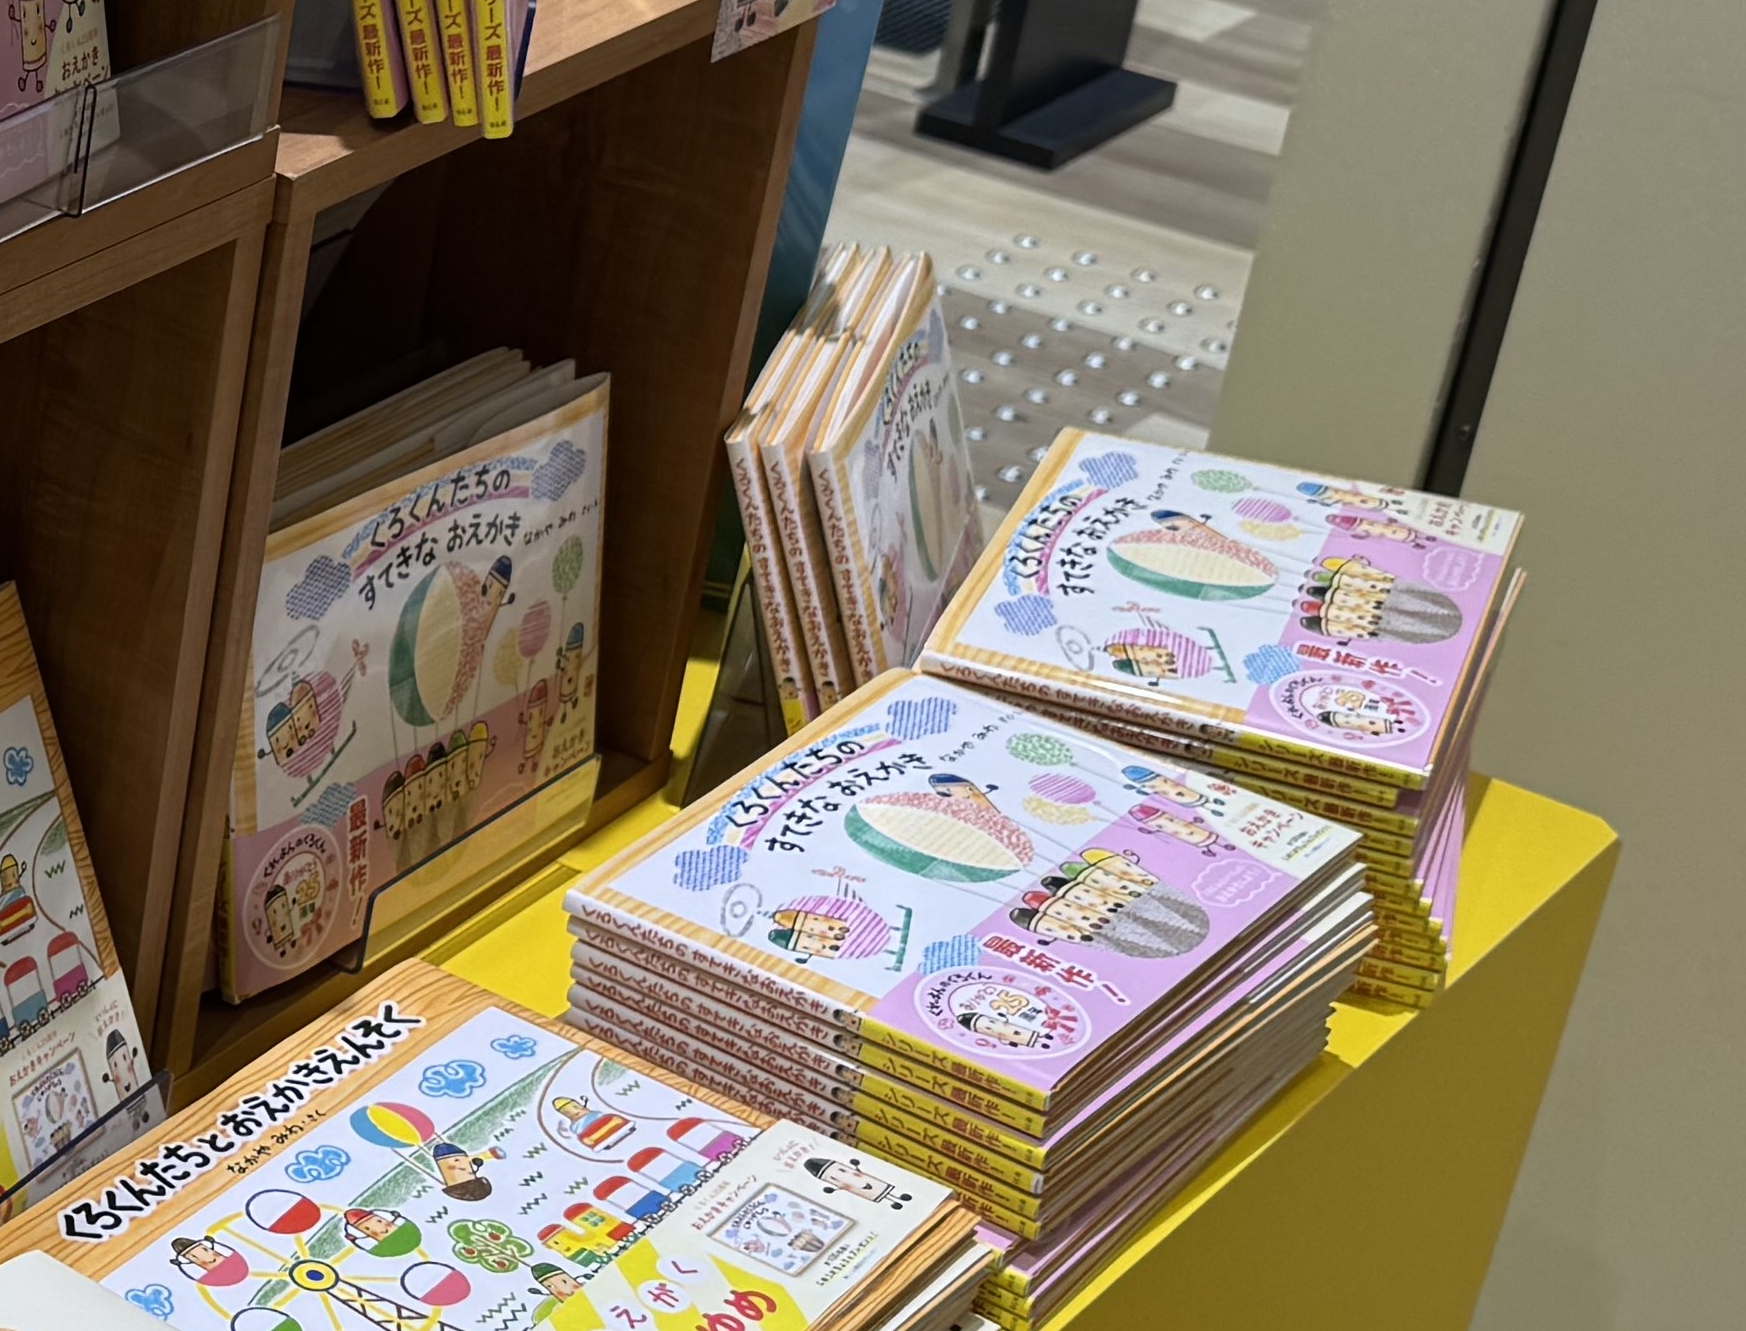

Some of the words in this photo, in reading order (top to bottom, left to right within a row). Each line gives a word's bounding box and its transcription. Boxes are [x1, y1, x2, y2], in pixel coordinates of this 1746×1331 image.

[1018, 494, 1084, 580] くろくんたちの
[725, 739, 866, 829] くろくんたちの
[980, 934, 1131, 1006] 最新作!
[61, 999, 427, 1242] くろくんたちとおえかきえんそく
